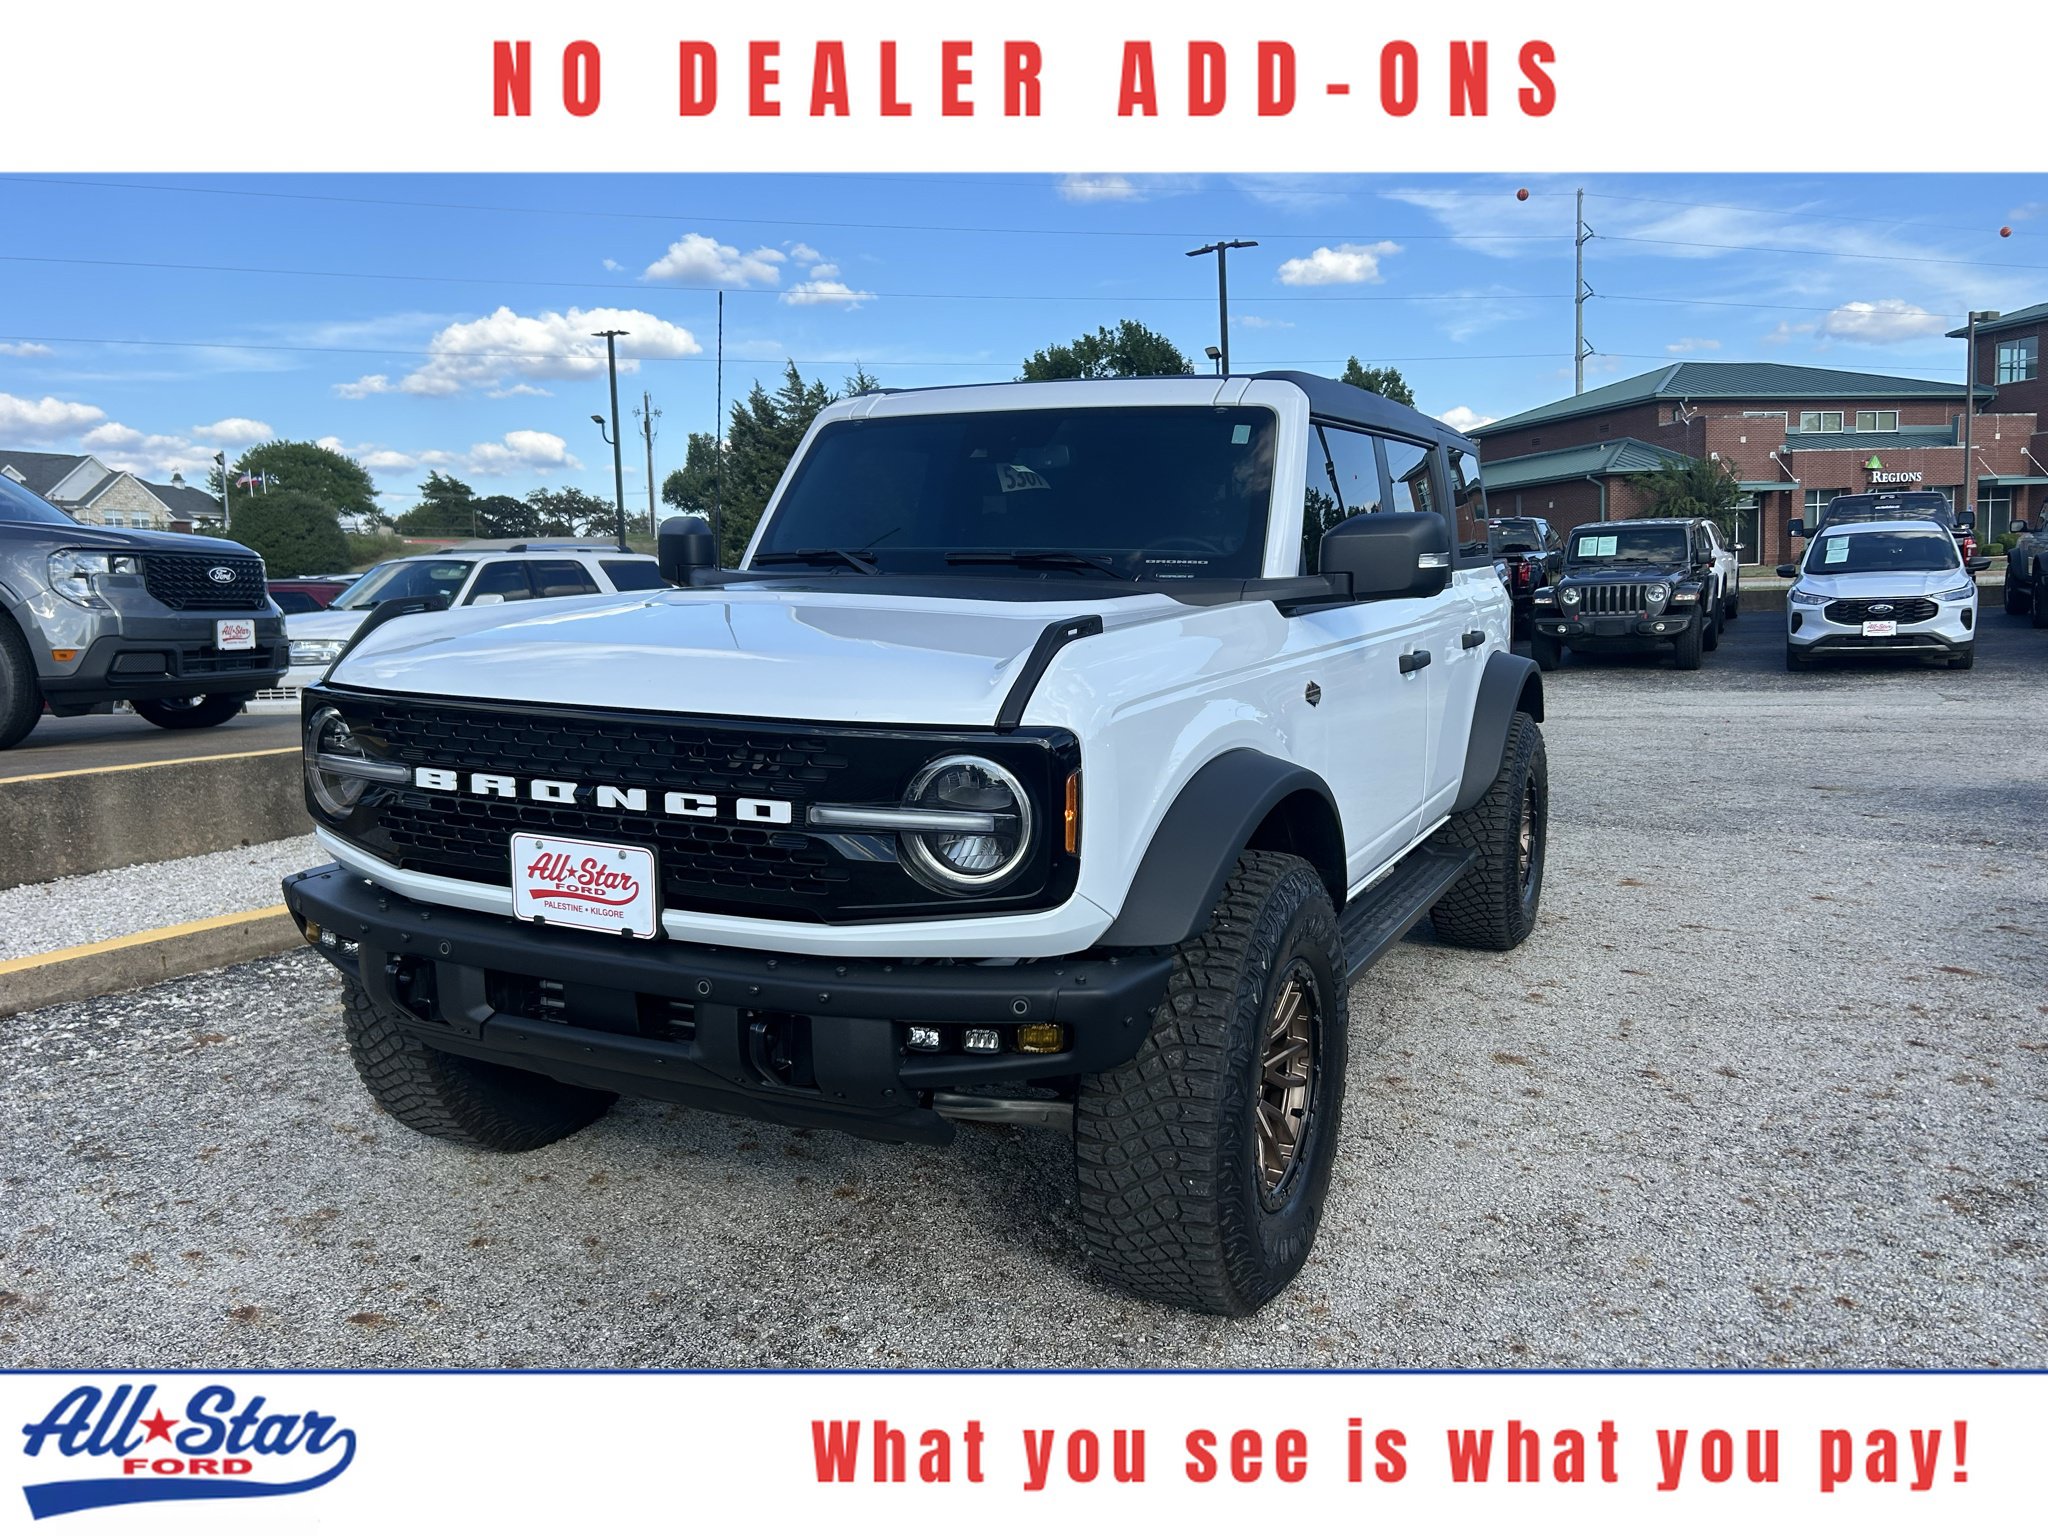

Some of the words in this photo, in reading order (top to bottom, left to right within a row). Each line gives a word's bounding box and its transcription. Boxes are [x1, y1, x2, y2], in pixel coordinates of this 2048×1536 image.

[214, 569, 232, 580] Ford
[415, 766, 792, 825] BRONCO
[527, 852, 567, 883] All
[577, 857, 635, 890] Star
[555, 882, 607, 896] FORD
[543, 900, 584, 913] PALESTINE
[590, 908, 625, 919] KILGORE
